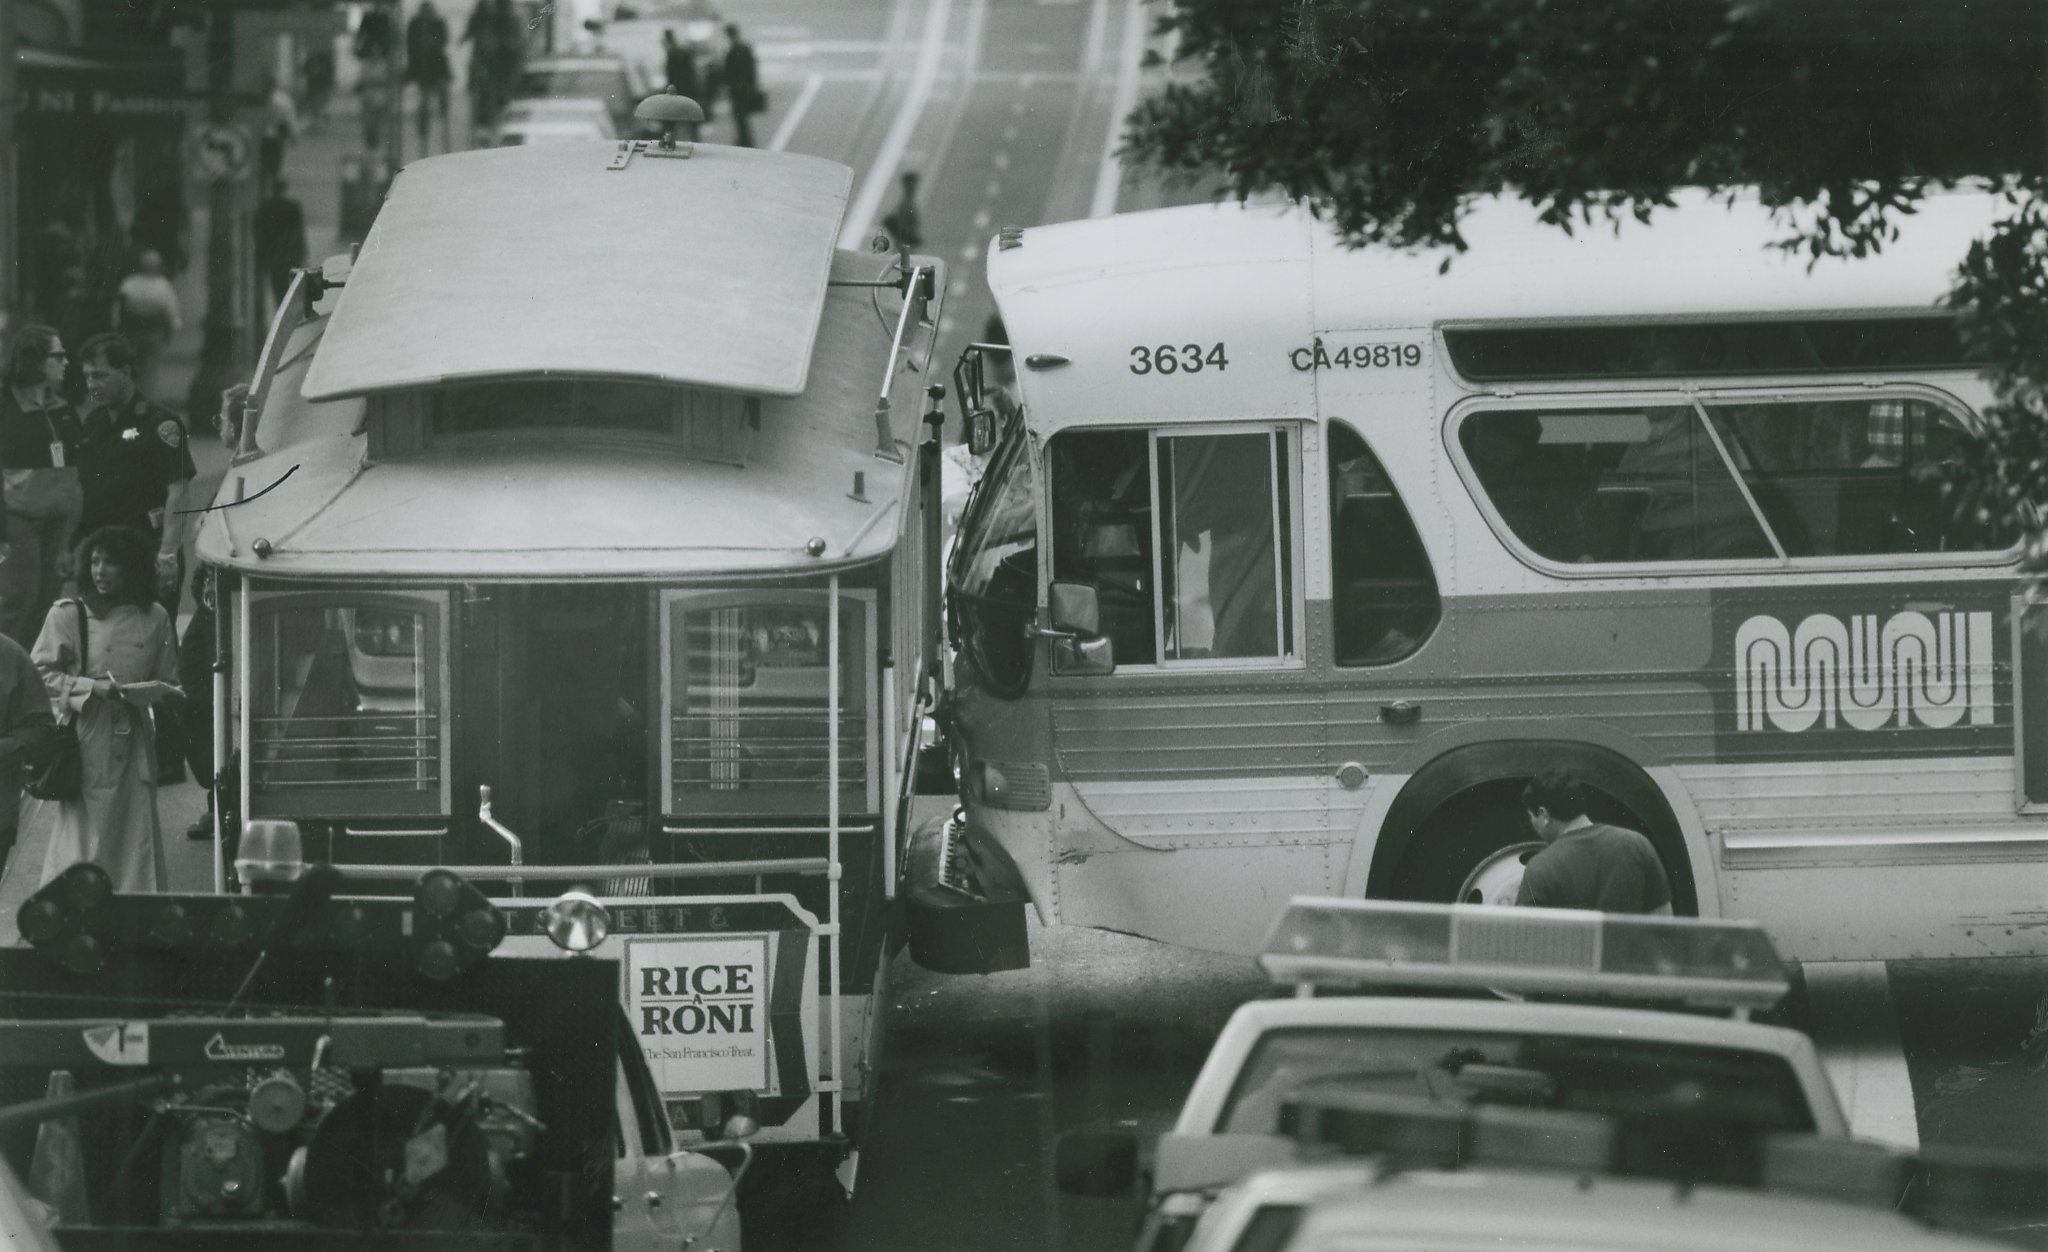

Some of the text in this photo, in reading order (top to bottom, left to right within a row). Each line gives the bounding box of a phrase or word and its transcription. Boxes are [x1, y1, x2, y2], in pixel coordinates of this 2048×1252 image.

[1129, 342, 1229, 375] 3634
[1291, 343, 1421, 372] CA49819
[641, 964, 754, 996] RICE
[692, 994, 703, 1005] A
[641, 1004, 754, 1035] RONI
[663, 1047, 682, 1060] San
[683, 1046, 730, 1060] Francisco
